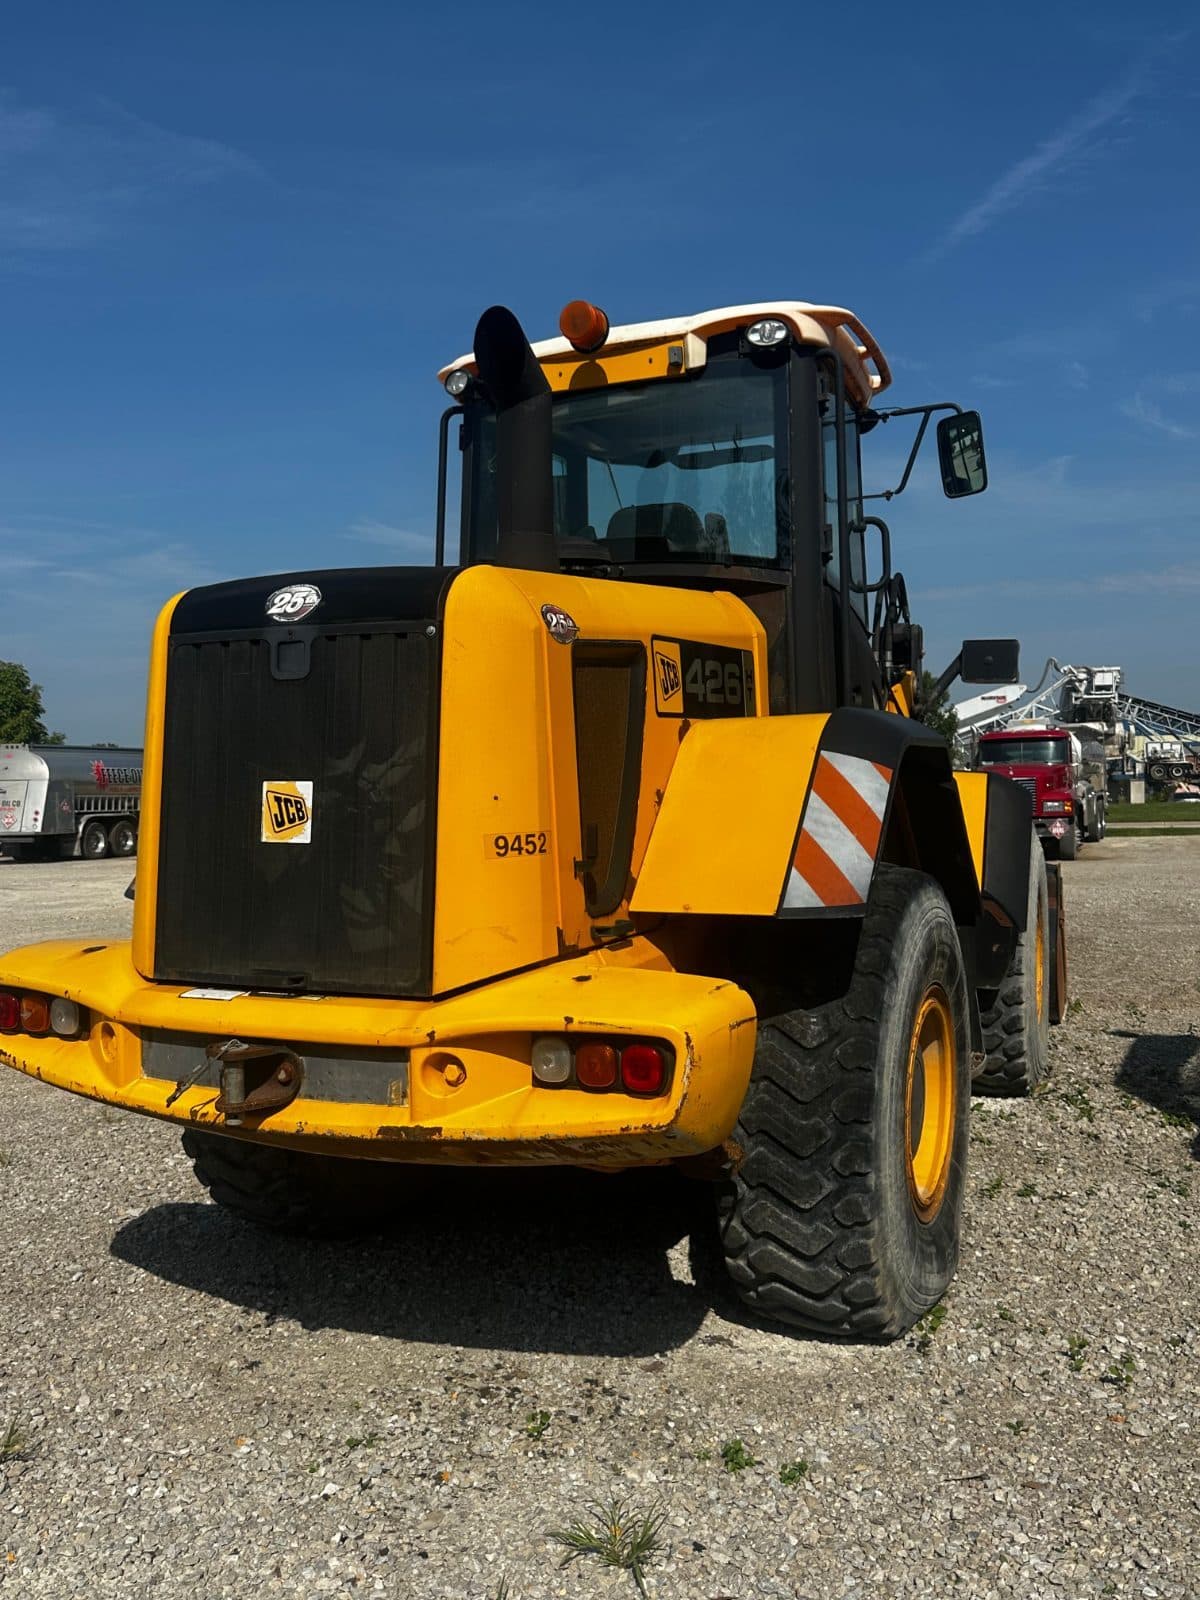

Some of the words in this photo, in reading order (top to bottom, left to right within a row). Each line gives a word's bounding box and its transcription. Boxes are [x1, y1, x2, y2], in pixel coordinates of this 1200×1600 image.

[660, 658, 679, 695] JCB
[685, 658, 742, 705] 426
[274, 795, 306, 828] JCB
[494, 833, 547, 857] 9452
